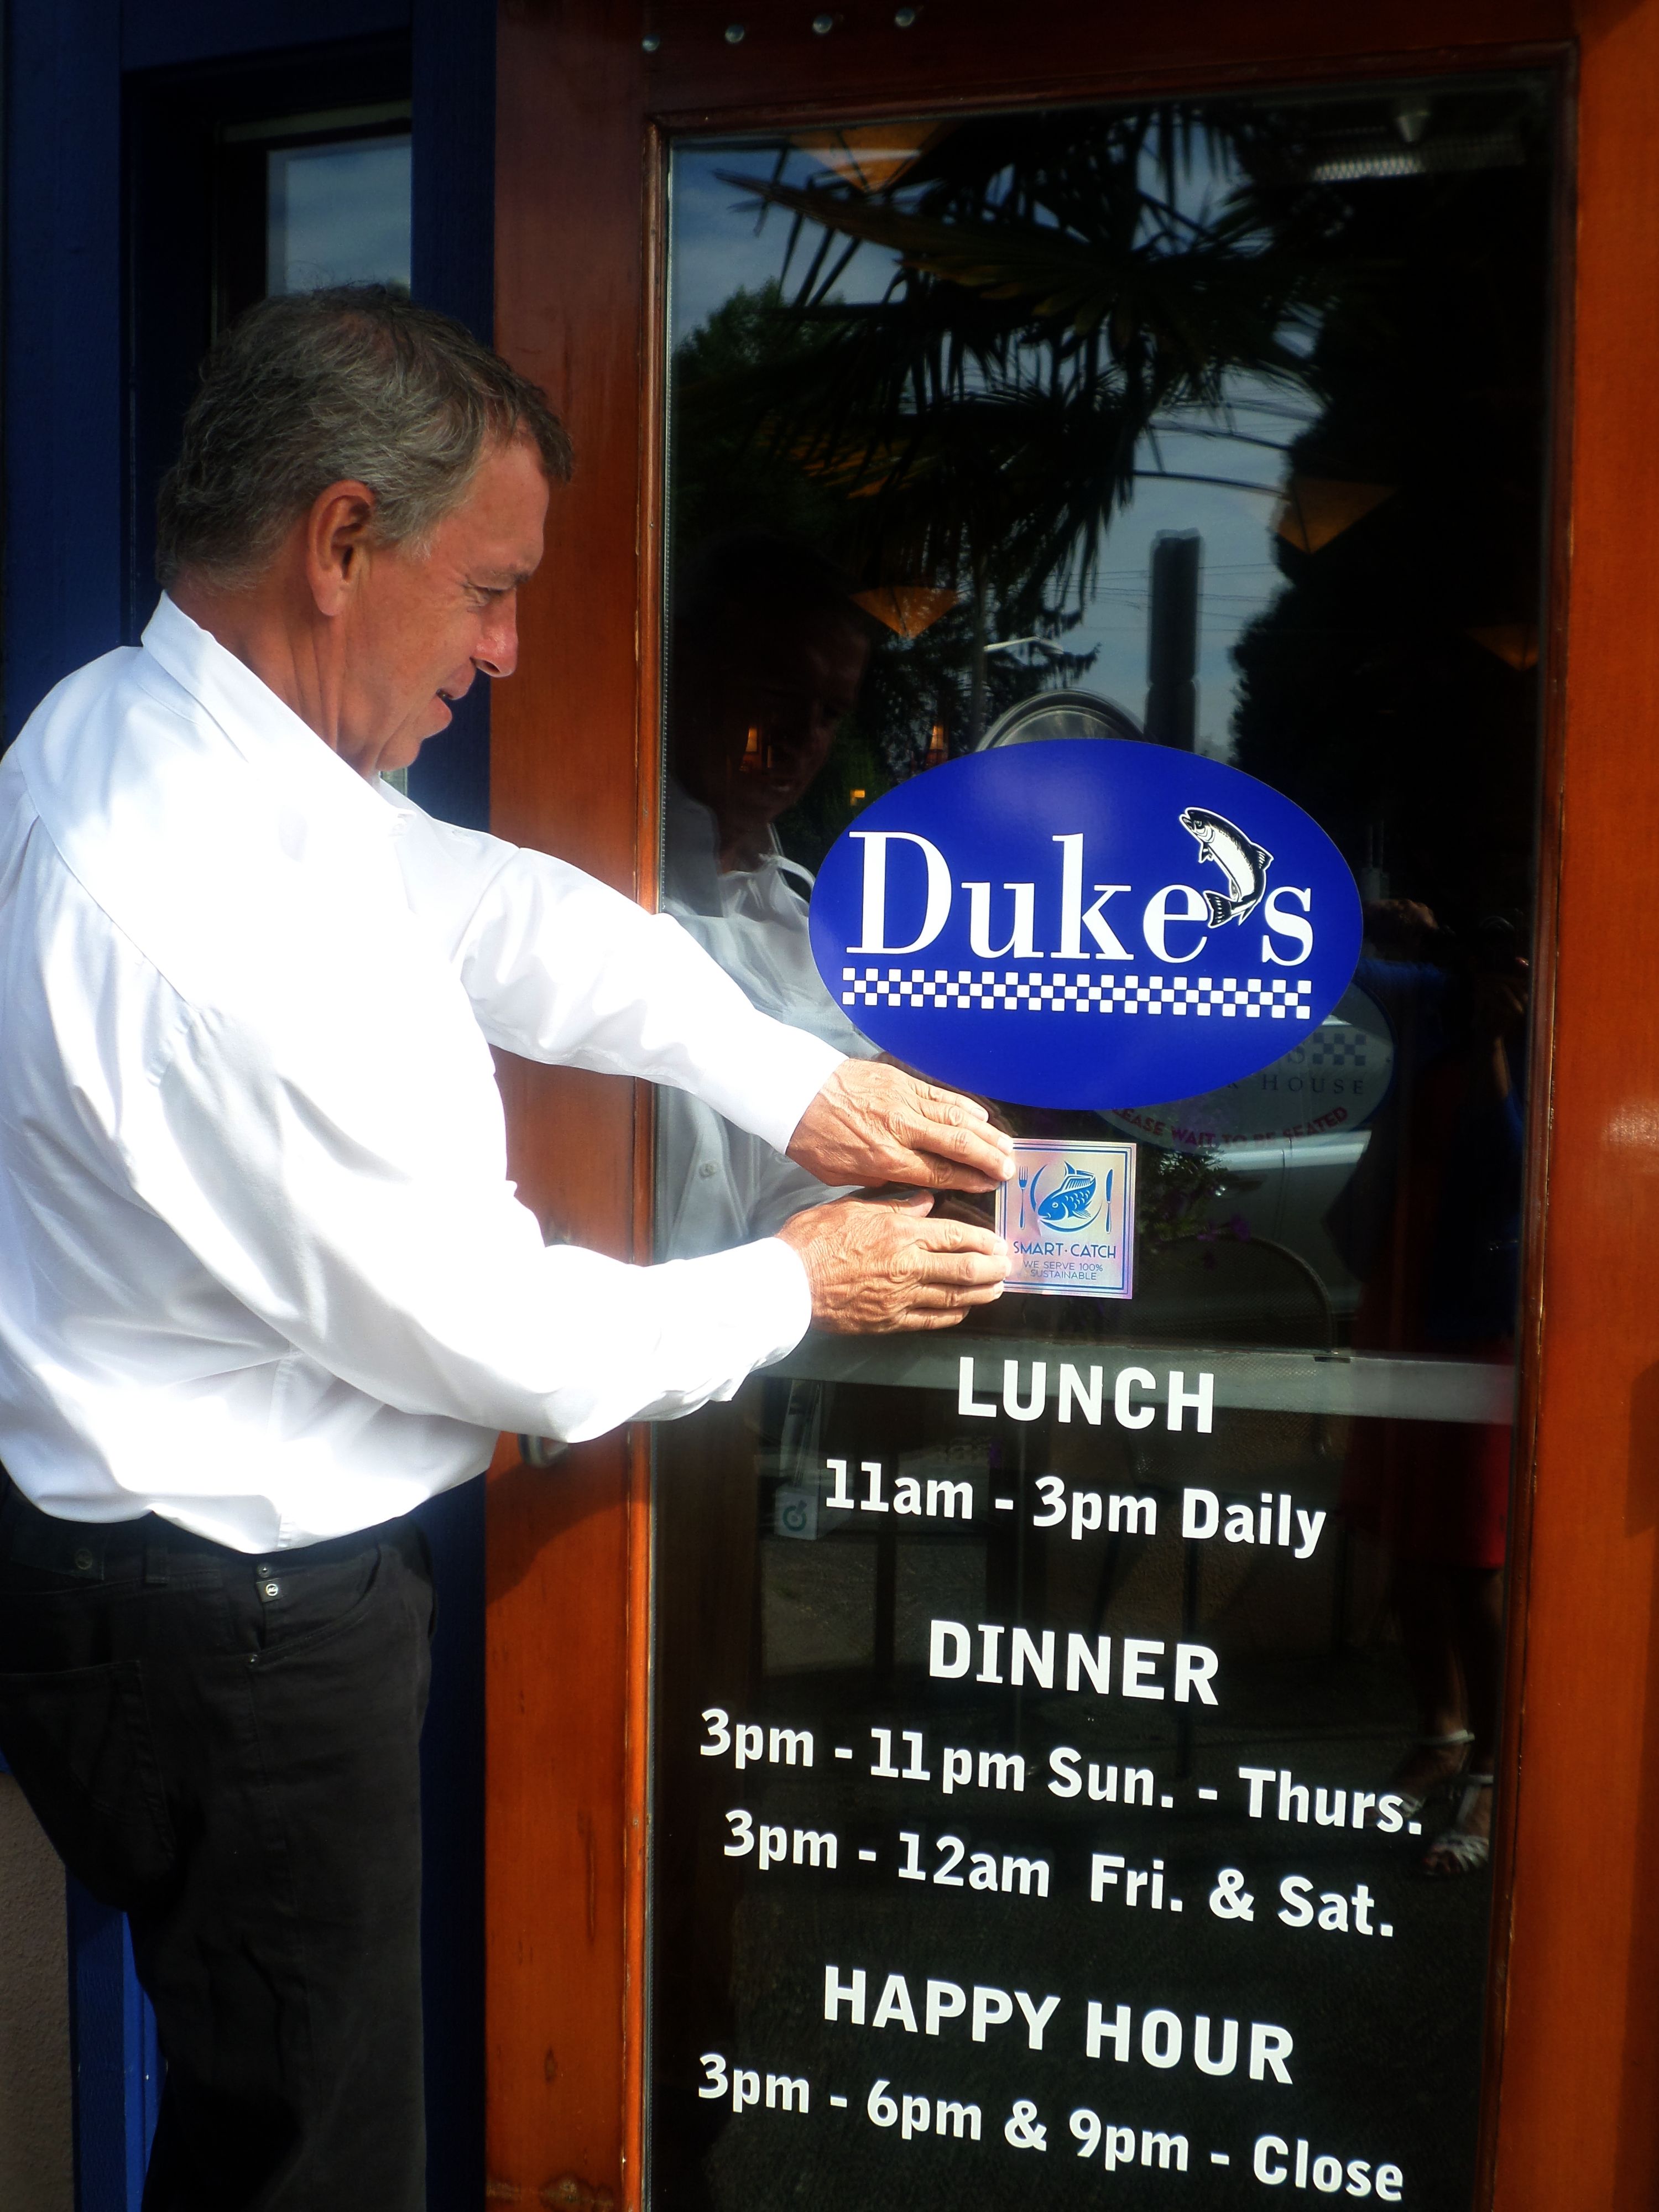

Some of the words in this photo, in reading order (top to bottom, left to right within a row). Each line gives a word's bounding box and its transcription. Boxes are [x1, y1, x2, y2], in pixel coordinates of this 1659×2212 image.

[1171, 1124, 1216, 1146] WAIT
[1282, 1106, 1348, 1139] SEATED
[1261, 1074, 1364, 1095] HOUSE
[1024, 1260, 1039, 1269] WE
[1044, 1261, 1075, 1270] SERVE
[1079, 1262, 1103, 1272] 100%
[1030, 1269, 1097, 1280] SUSTAINABLE
[959, 1357, 1214, 1433] LUNCH
[827, 1459, 973, 1519] 11am
[1034, 1476, 1156, 1540] 3pm
[1182, 1488, 1326, 1558] Daily
[930, 1620, 1218, 1705] DINNER
[701, 1709, 813, 1769] 3pm
[1048, 1747, 1173, 1808] Sun.
[1239, 1767, 1421, 1834] Thurs.
[724, 1810, 837, 1870] 3pm
[899, 1833, 1049, 1897] 12am
[1091, 1854, 1182, 1911] Fri.
[1209, 1869, 1254, 1921] &
[1279, 1876, 1392, 1937] Sat.
[825, 1966, 1061, 2050] HAPPY
[1087, 2002, 1293, 2084] HOUR
[699, 2054, 808, 2113] 3pm
[868, 2080, 981, 2140] 6pm
[1005, 2100, 1046, 2151] &
[1070, 2109, 1188, 2171] 9pm
[1254, 2136, 1402, 2200] Close
